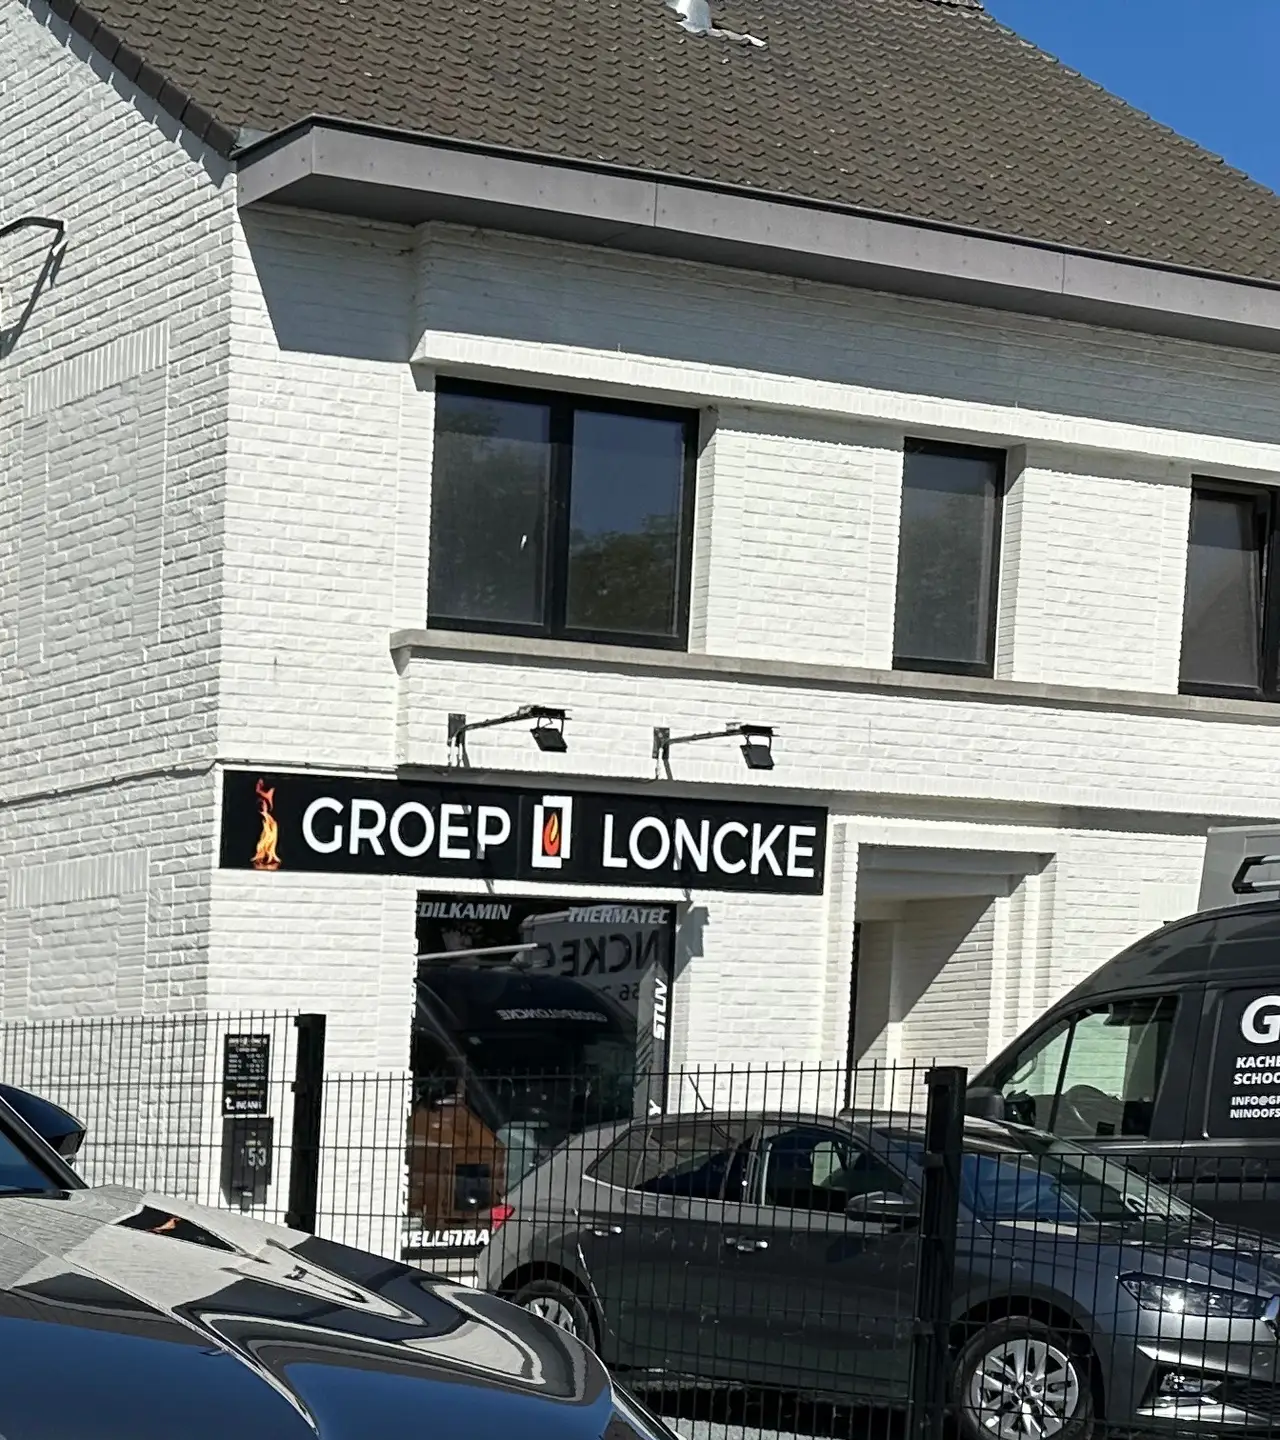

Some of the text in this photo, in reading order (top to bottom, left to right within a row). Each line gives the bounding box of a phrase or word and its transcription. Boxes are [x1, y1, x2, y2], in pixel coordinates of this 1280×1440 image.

[302, 797, 817, 878] GROEP LONCKE
[568, 906, 670, 924] THERMATEC
[653, 978, 667, 1041] STUV
